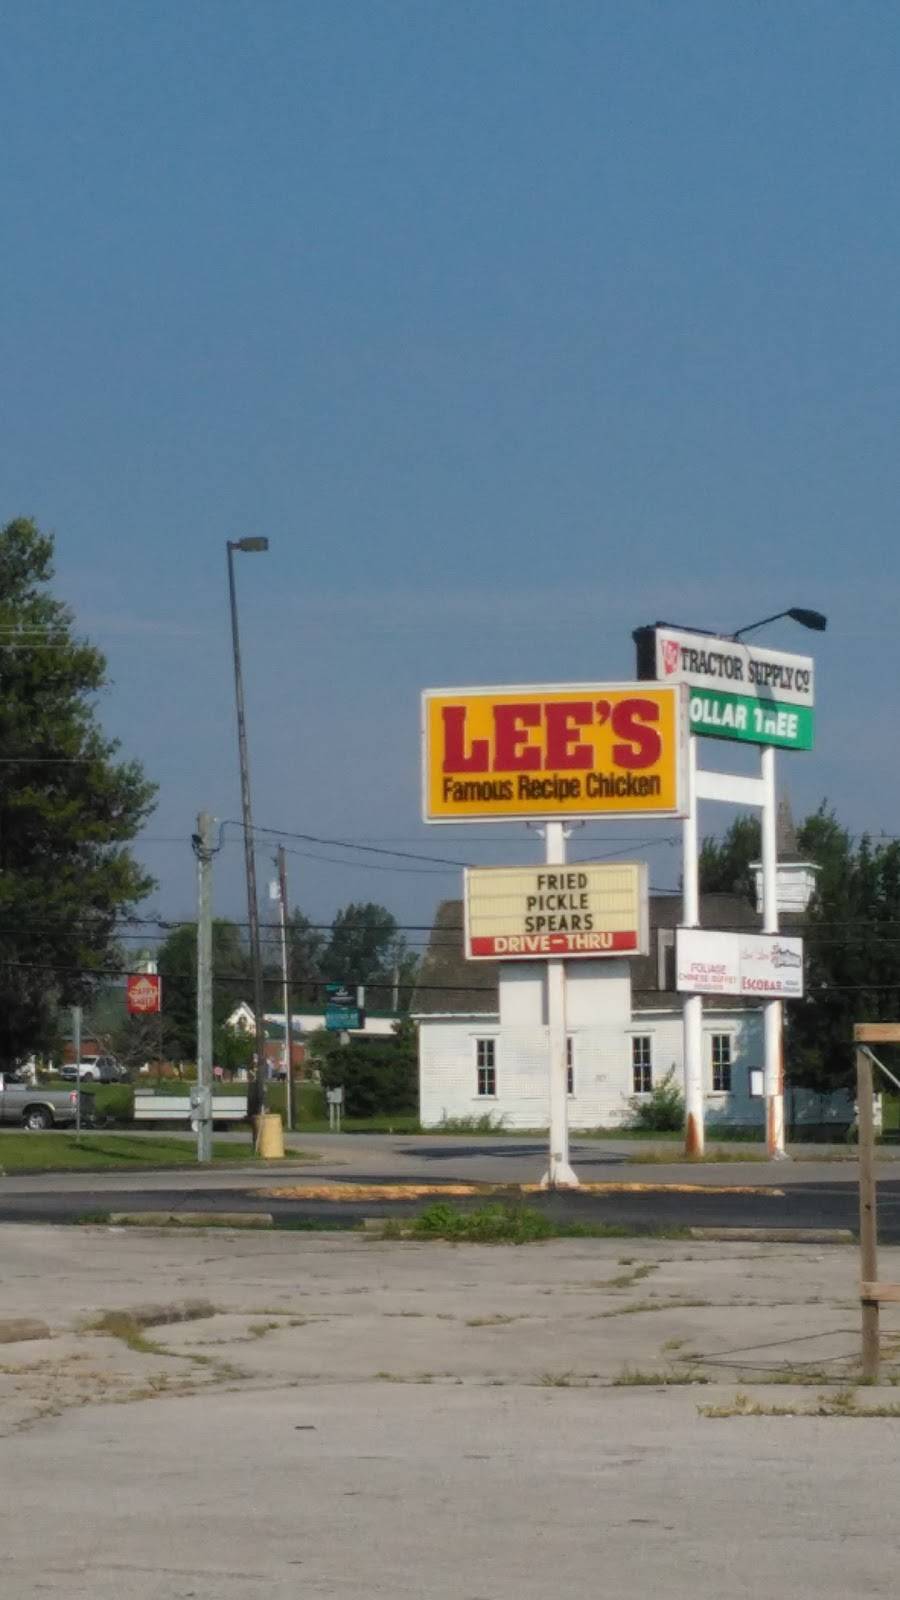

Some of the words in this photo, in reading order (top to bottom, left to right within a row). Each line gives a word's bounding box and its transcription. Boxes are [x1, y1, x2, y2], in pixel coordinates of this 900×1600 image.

[681, 647, 744, 681] TRACTOR
[747, 660, 793, 690] SUPPLY
[689, 697, 748, 731] OLLAR
[442, 698, 662, 773] LEE'S
[443, 776, 514, 802] Famous
[518, 774, 581, 802] Recipe
[586, 771, 661, 799] Chicken
[537, 873, 588, 890] FRIED
[527, 893, 589, 911] PICKLE
[525, 914, 594, 932] SPEARS
[494, 932, 613, 953] DRIVE-THRU
